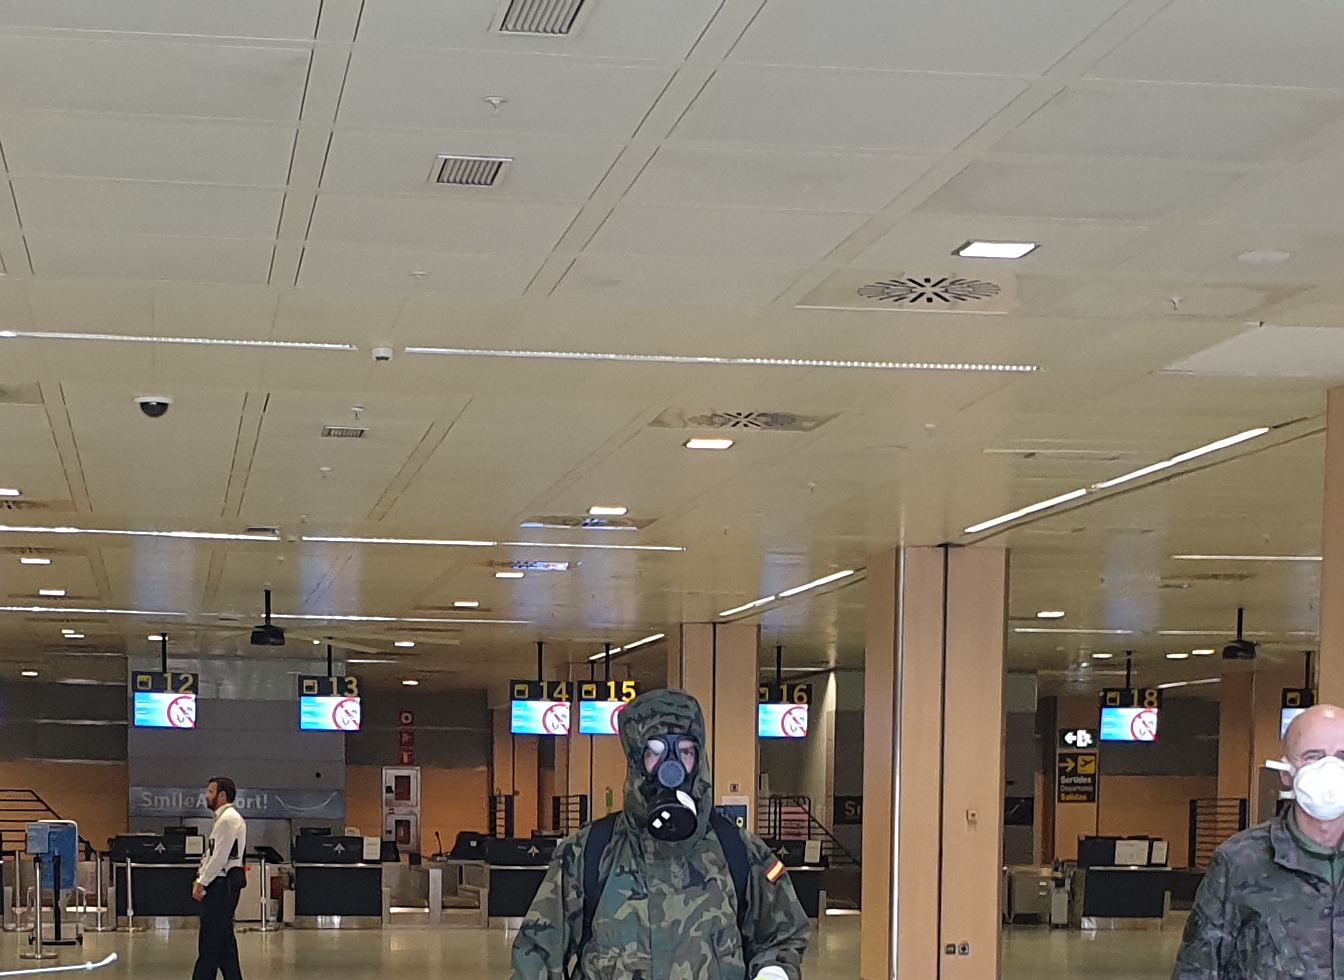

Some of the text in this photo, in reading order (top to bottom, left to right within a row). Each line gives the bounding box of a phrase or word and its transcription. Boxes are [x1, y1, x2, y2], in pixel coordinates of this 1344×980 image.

[163, 672, 195, 694] 12
[328, 676, 359, 697] 13
[539, 680, 570, 702] 14
[606, 680, 637, 702] 15
[779, 683, 808, 704] 16
[1130, 688, 1159, 708] 18
